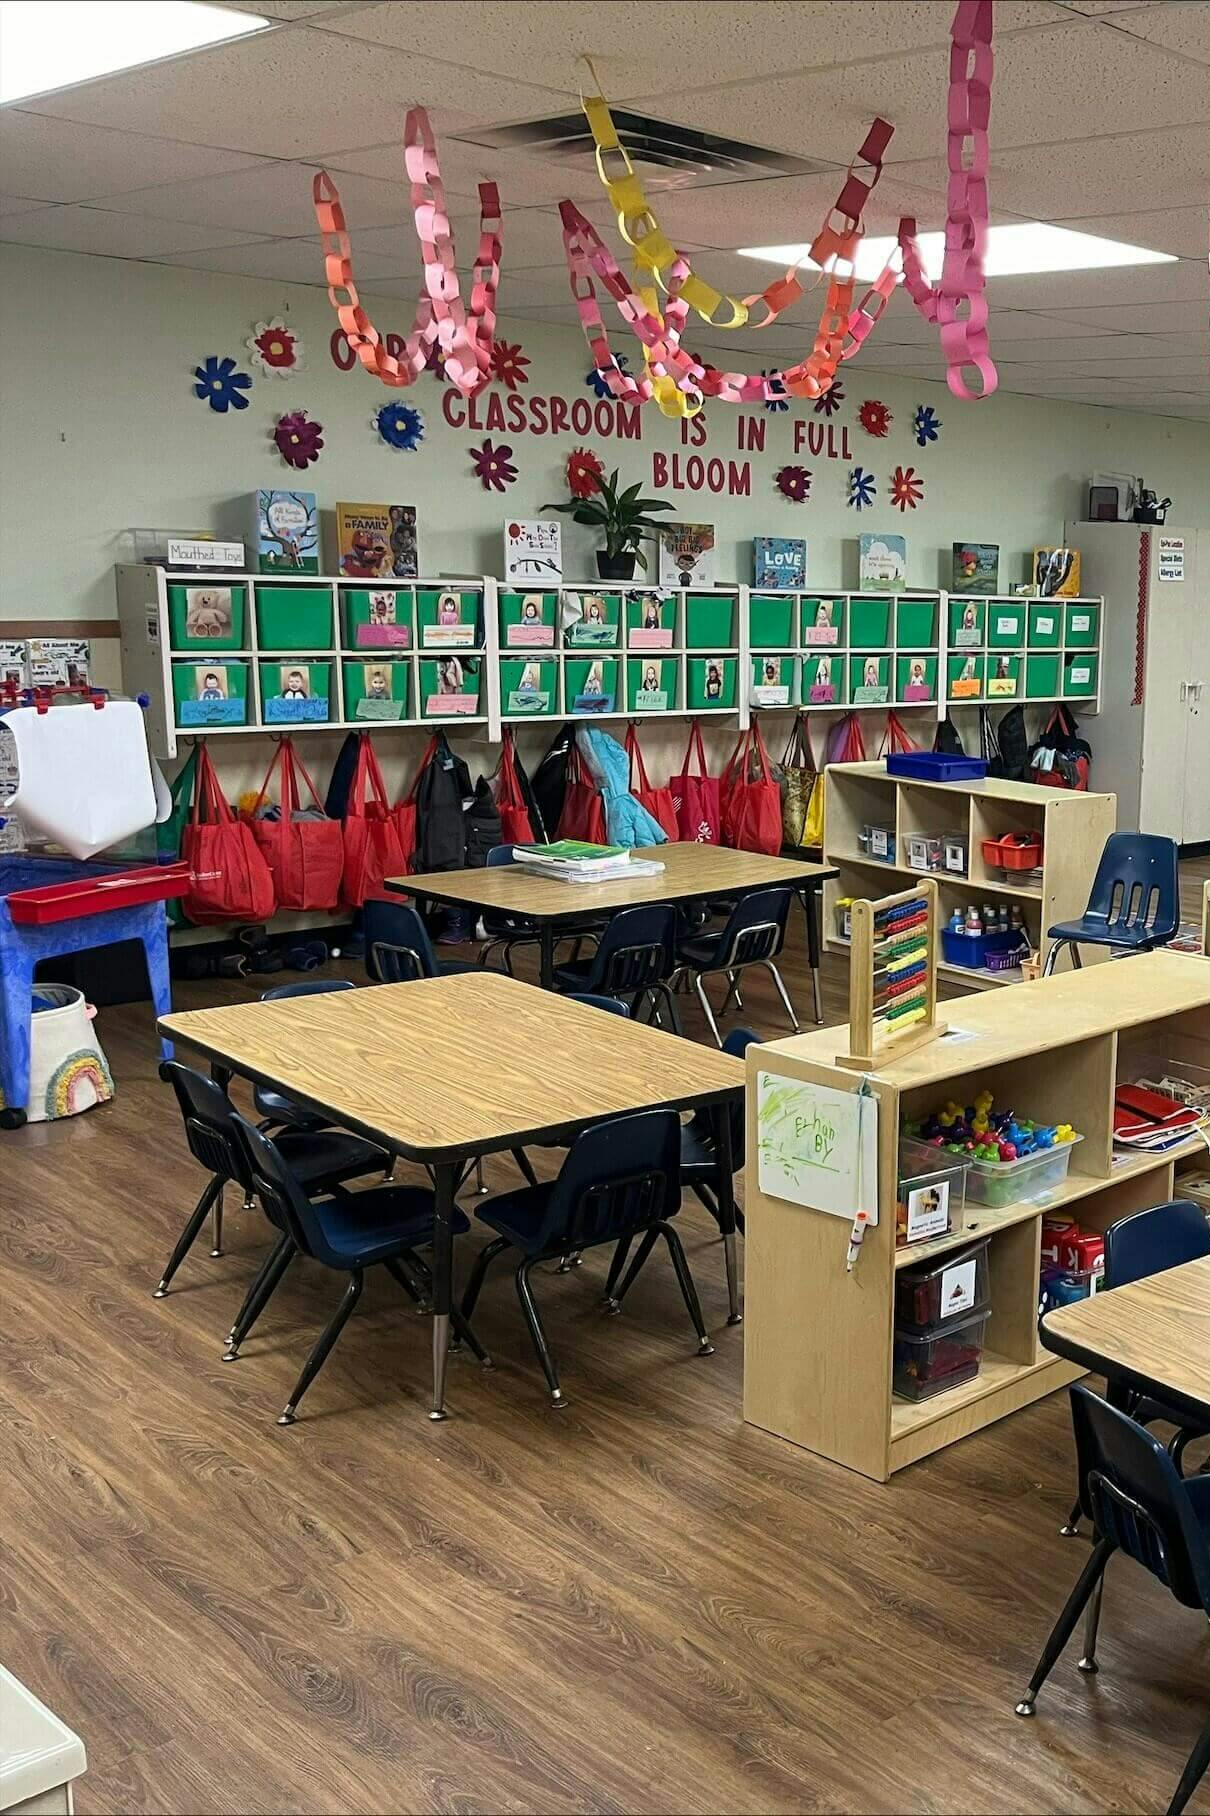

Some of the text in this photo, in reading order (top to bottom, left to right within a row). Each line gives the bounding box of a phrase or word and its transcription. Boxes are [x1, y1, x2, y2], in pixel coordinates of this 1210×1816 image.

[331, 328, 407, 374] OR
[442, 387, 854, 460] CLASSROOM IS IN FULL
[653, 452, 751, 496] BLOOM
[351, 520, 388, 530] FAMILY
[170, 544, 242, 564] Mouthed Toys
[764, 551, 802, 566] LOVE
